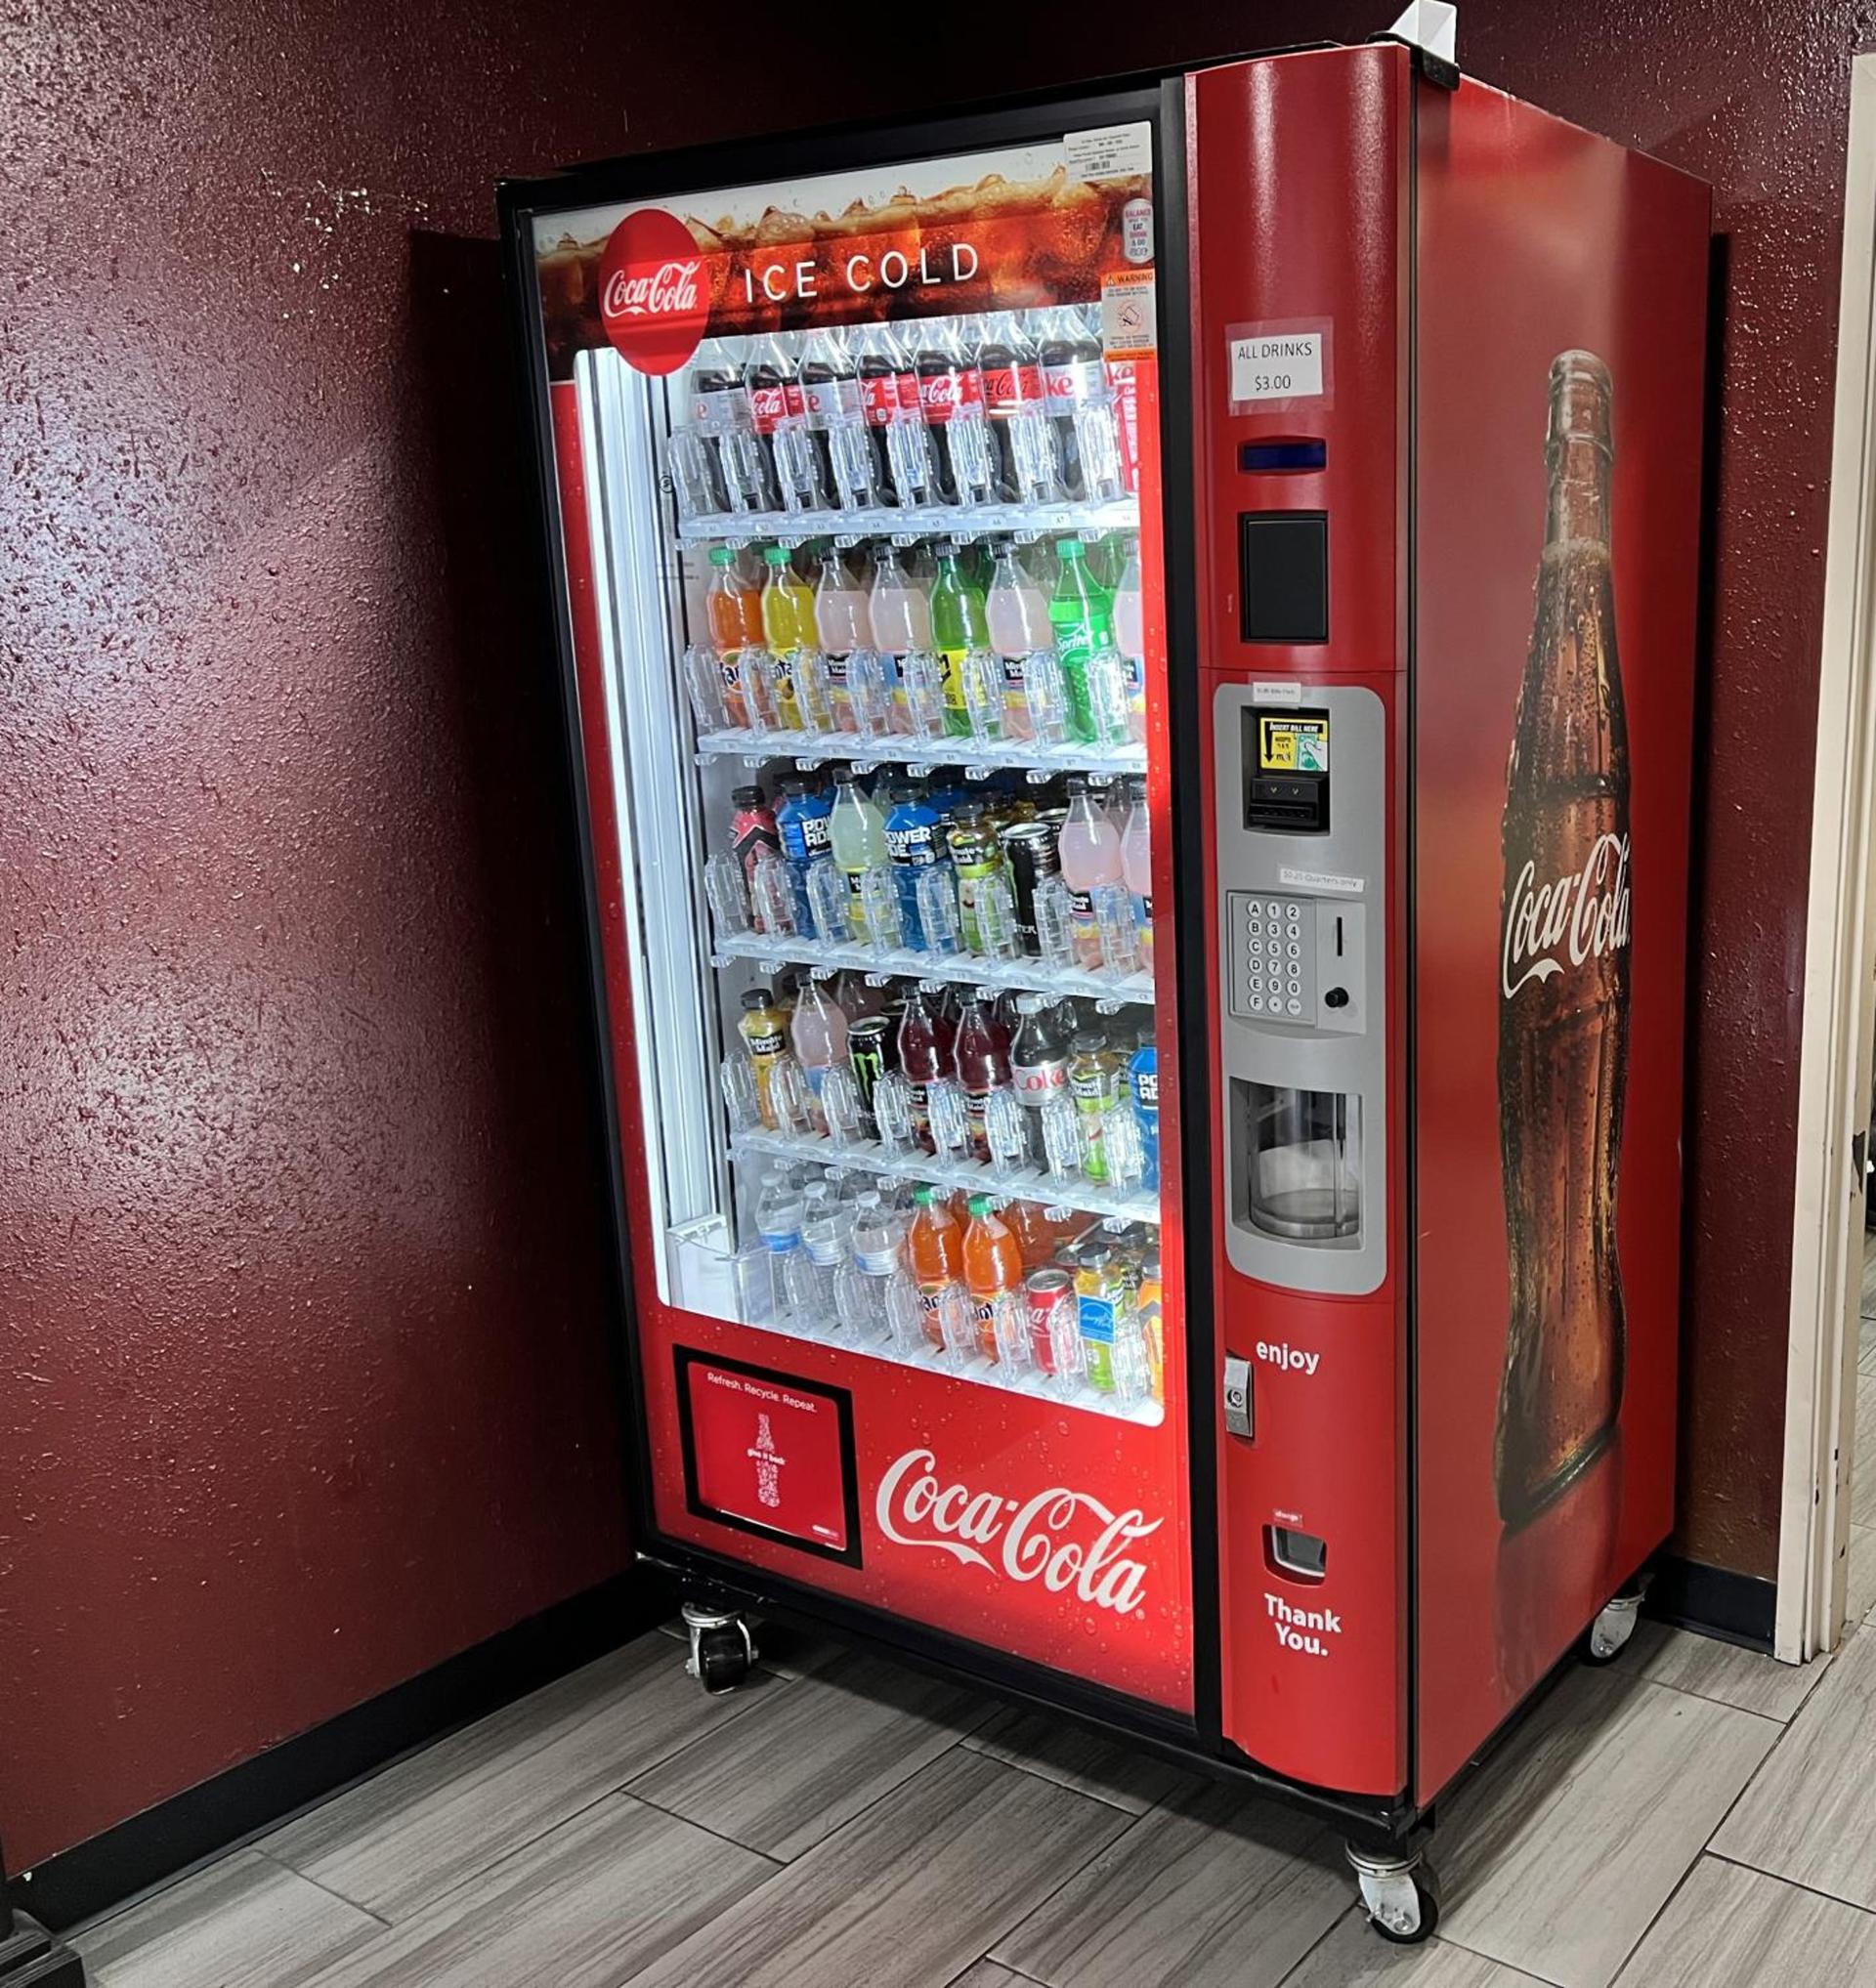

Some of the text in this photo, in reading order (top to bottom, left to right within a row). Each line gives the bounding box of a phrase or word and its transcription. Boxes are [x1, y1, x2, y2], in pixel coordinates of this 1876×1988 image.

[745, 242, 979, 304] ICE COLD
[1117, 273, 1153, 283] WARNING
[603, 260, 701, 318] Coca-Cola
[1238, 342, 1312, 360] ALL DRINKS
[1255, 374, 1292, 392] $3.00
[885, 825, 931, 844] OWER
[1252, 905, 1297, 917] A 1 2
[1503, 832, 1630, 998] Coca-Cola
[1252, 923, 1298, 936] B 3 4
[1252, 942, 1298, 955] C 5 6
[1253, 960, 1298, 975] D 7 8
[1253, 979, 1298, 994] E 9 0
[1253, 997, 1260, 1007] F
[1016, 1068, 1065, 1091] Coke
[1256, 1340, 1320, 1375] enjoy
[706, 1372, 818, 1413] Refresh. Recycle. Repeat.
[875, 1448, 1165, 1614] Coca-Cola
[1263, 1592, 1343, 1633] Thank
[1274, 1622, 1329, 1657] You.
